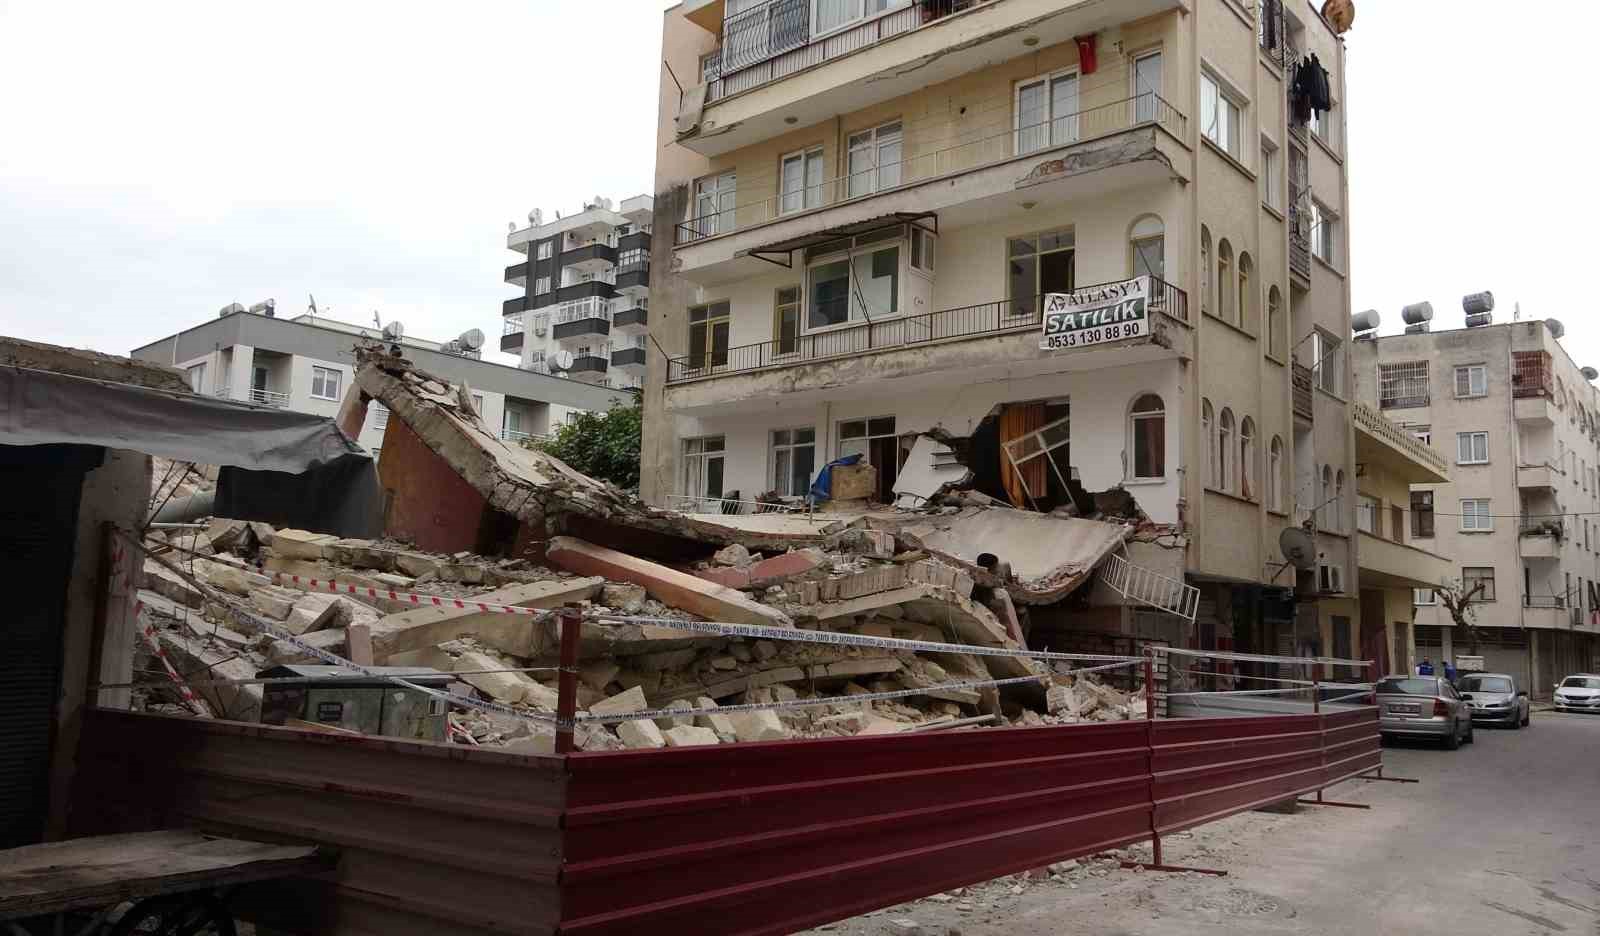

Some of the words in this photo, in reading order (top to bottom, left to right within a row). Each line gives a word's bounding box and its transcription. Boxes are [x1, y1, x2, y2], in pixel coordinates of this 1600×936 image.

[1047, 301, 1138, 334] SATILIK
[1048, 335, 1076, 348] 0533
[1079, 328, 1101, 344] 130
[1105, 326, 1120, 339] 88
[1123, 322, 1140, 336] 90
